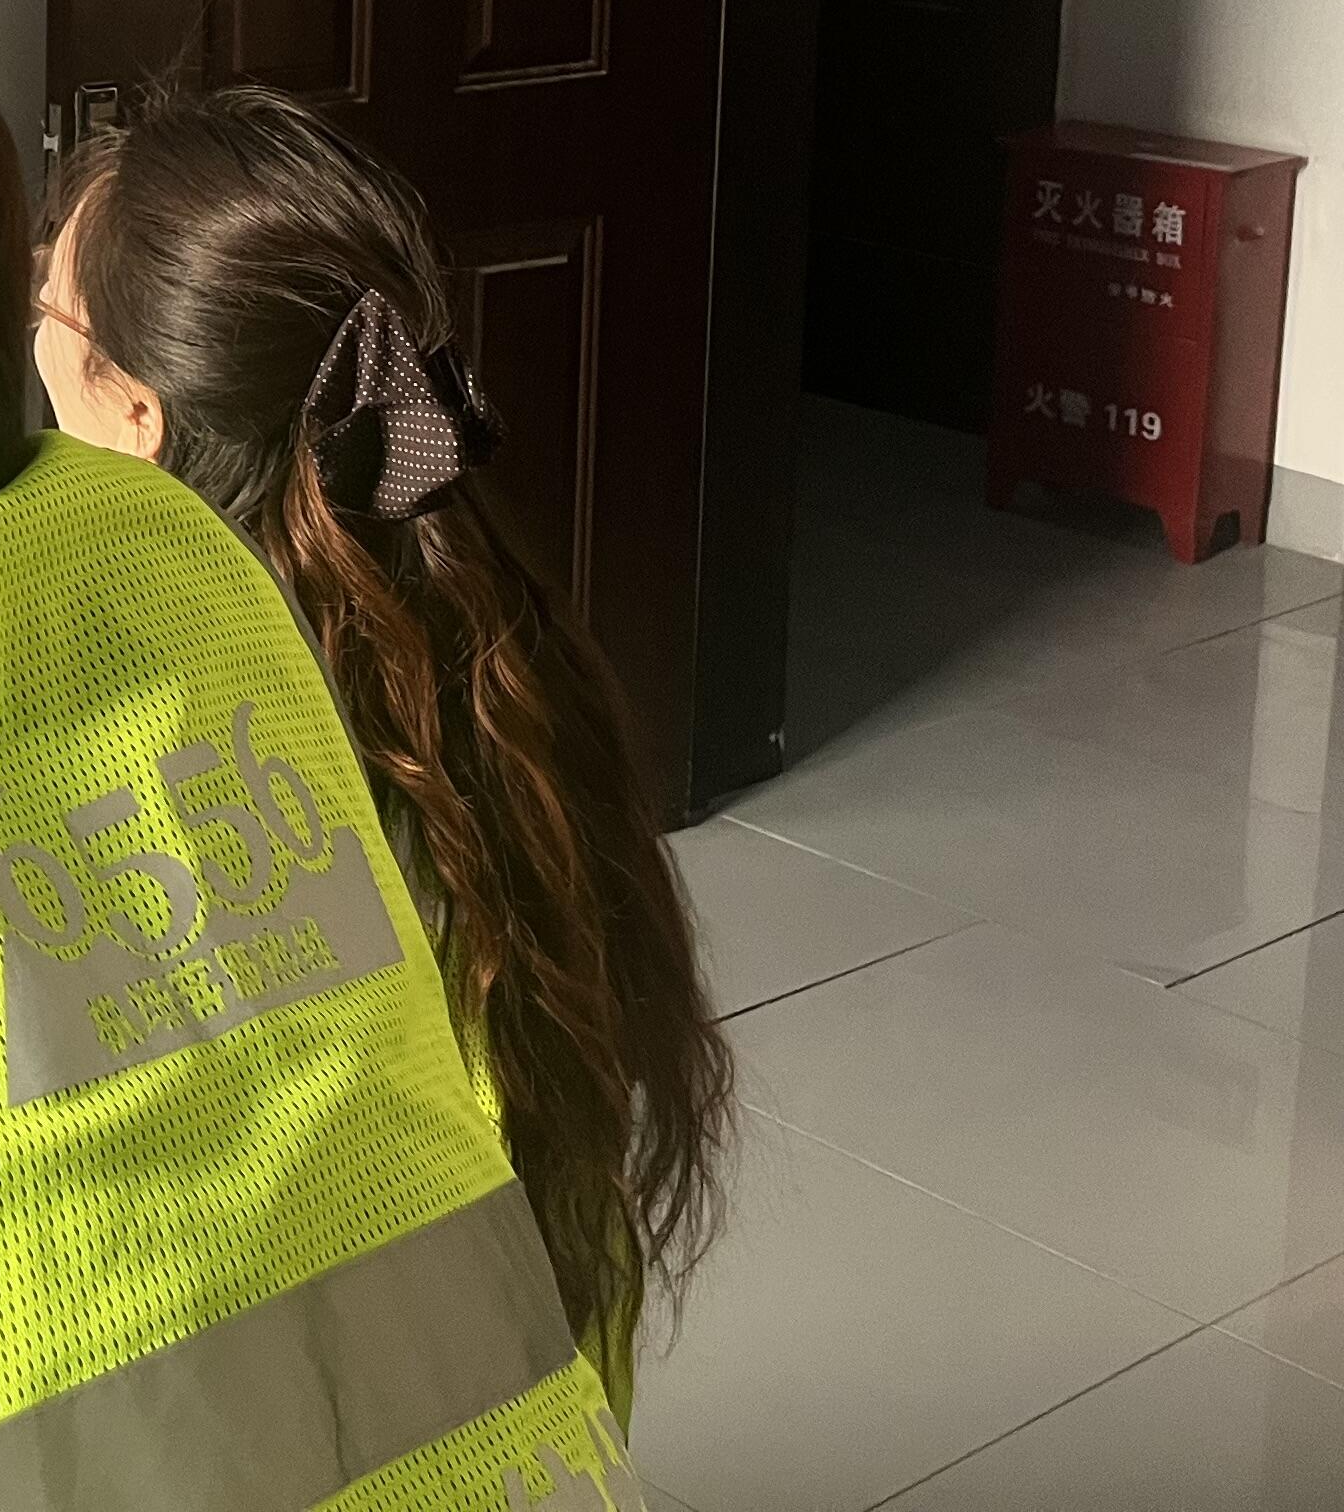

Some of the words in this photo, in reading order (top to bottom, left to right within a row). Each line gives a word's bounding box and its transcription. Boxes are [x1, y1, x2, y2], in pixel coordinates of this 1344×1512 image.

[1032, 180, 1187, 247] 灭火器箱
[1104, 402, 1163, 442] 119
